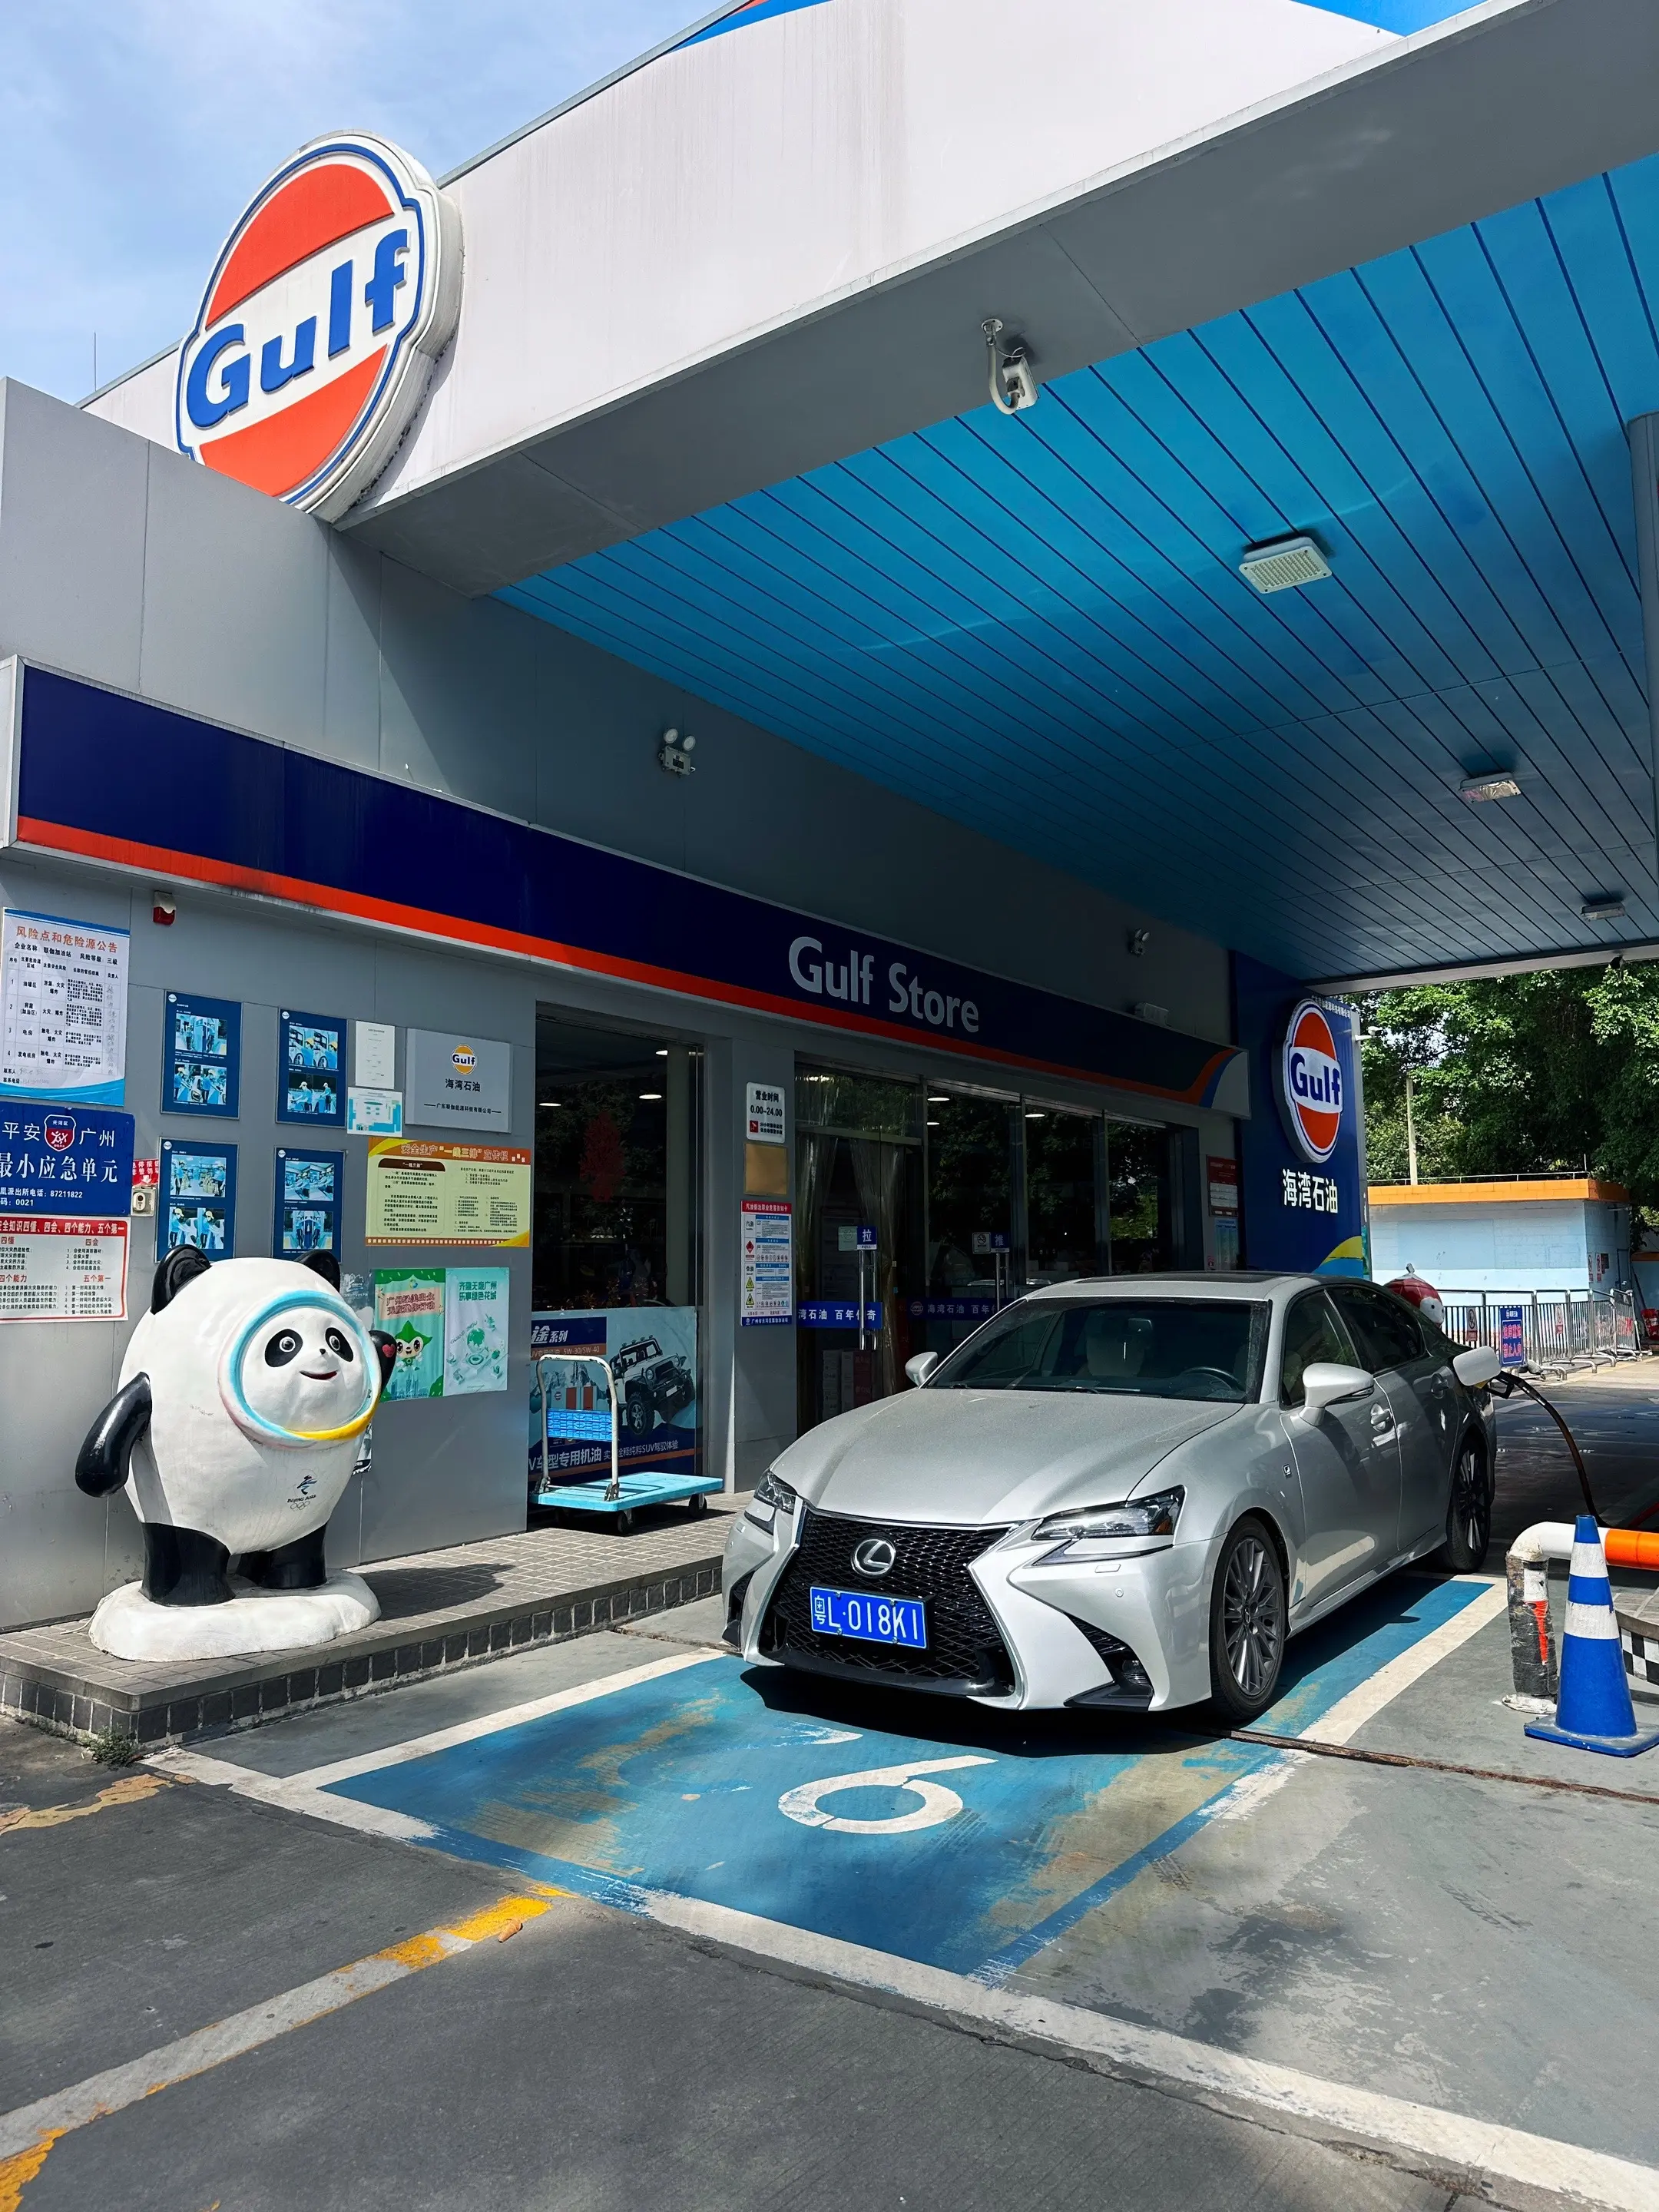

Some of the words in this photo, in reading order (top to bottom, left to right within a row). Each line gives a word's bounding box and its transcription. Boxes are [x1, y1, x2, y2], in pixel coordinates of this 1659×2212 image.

[187, 228, 409, 428] Gulf
[16, 926, 118, 953] 风险点和危险源公告
[789, 936, 874, 1005] Gulf
[889, 962, 979, 1033] Store
[452, 1054, 475, 1065] Gulf
[445, 1078, 481, 1093] 海湾石油
[1290, 1052, 1341, 1105] Gulf
[755, 1090, 780, 1103] 营业时间
[2, 1121, 41, 1141] 平安
[79, 1128, 115, 1147] 广州
[0, 1152, 118, 1183] 最小应急单元
[1282, 1168, 1339, 1214] 海湾石油
[1, 1237, 15, 1245] 四懂
[85, 1238, 99, 1247] 四会
[862, 1228, 873, 1243] 拉
[0, 1274, 27, 1283] 四个能力
[84, 1274, 111, 1283] 五个第一
[798, 1309, 828, 1320] 湾石油
[927, 1304, 965, 1314] 海湾石油
[604, 1440, 679, 1461] 实诠释纯粹SUV驾驭体验
[778, 1755, 998, 1834] 6
